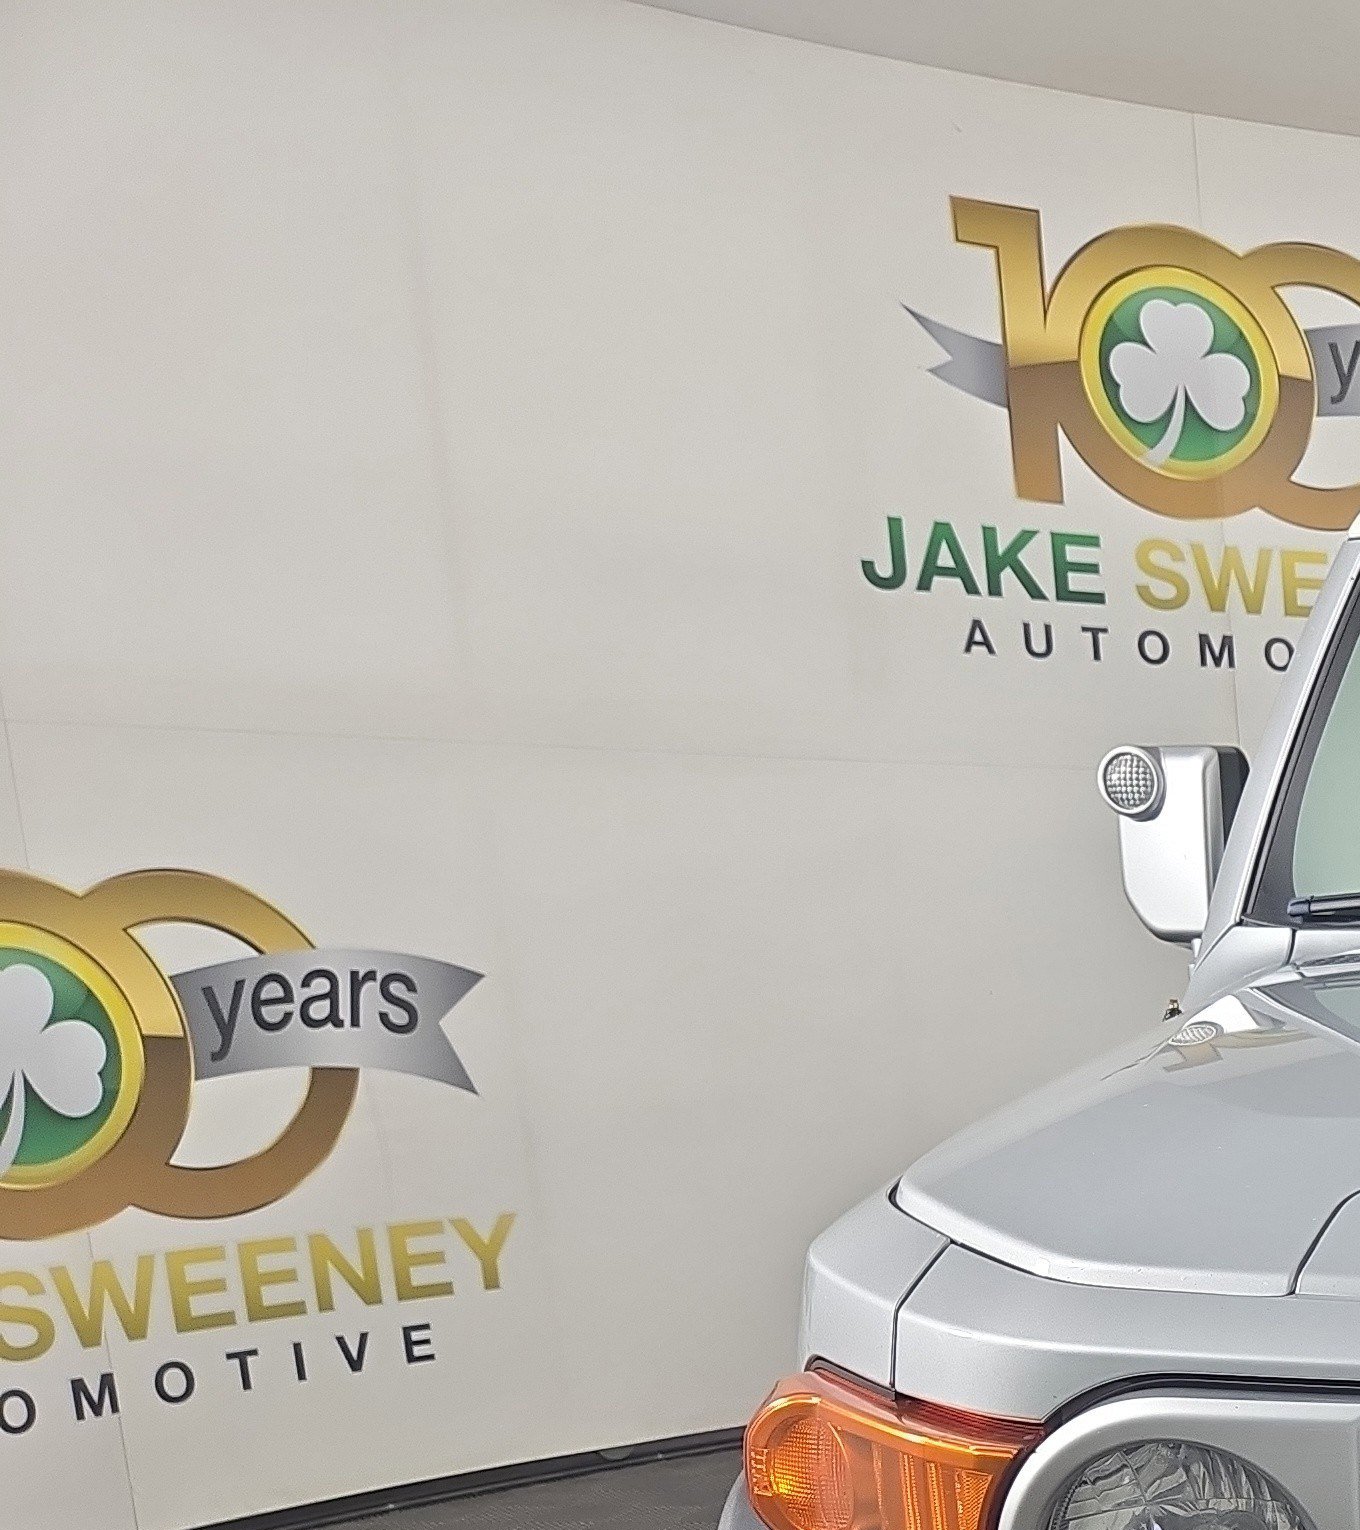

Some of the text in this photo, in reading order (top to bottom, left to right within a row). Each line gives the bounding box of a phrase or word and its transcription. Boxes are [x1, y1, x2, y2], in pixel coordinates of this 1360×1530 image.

[860, 515, 1107, 606] JAKE
[200, 967, 420, 1062] years
[0, 1212, 517, 1362] SWEENEY
